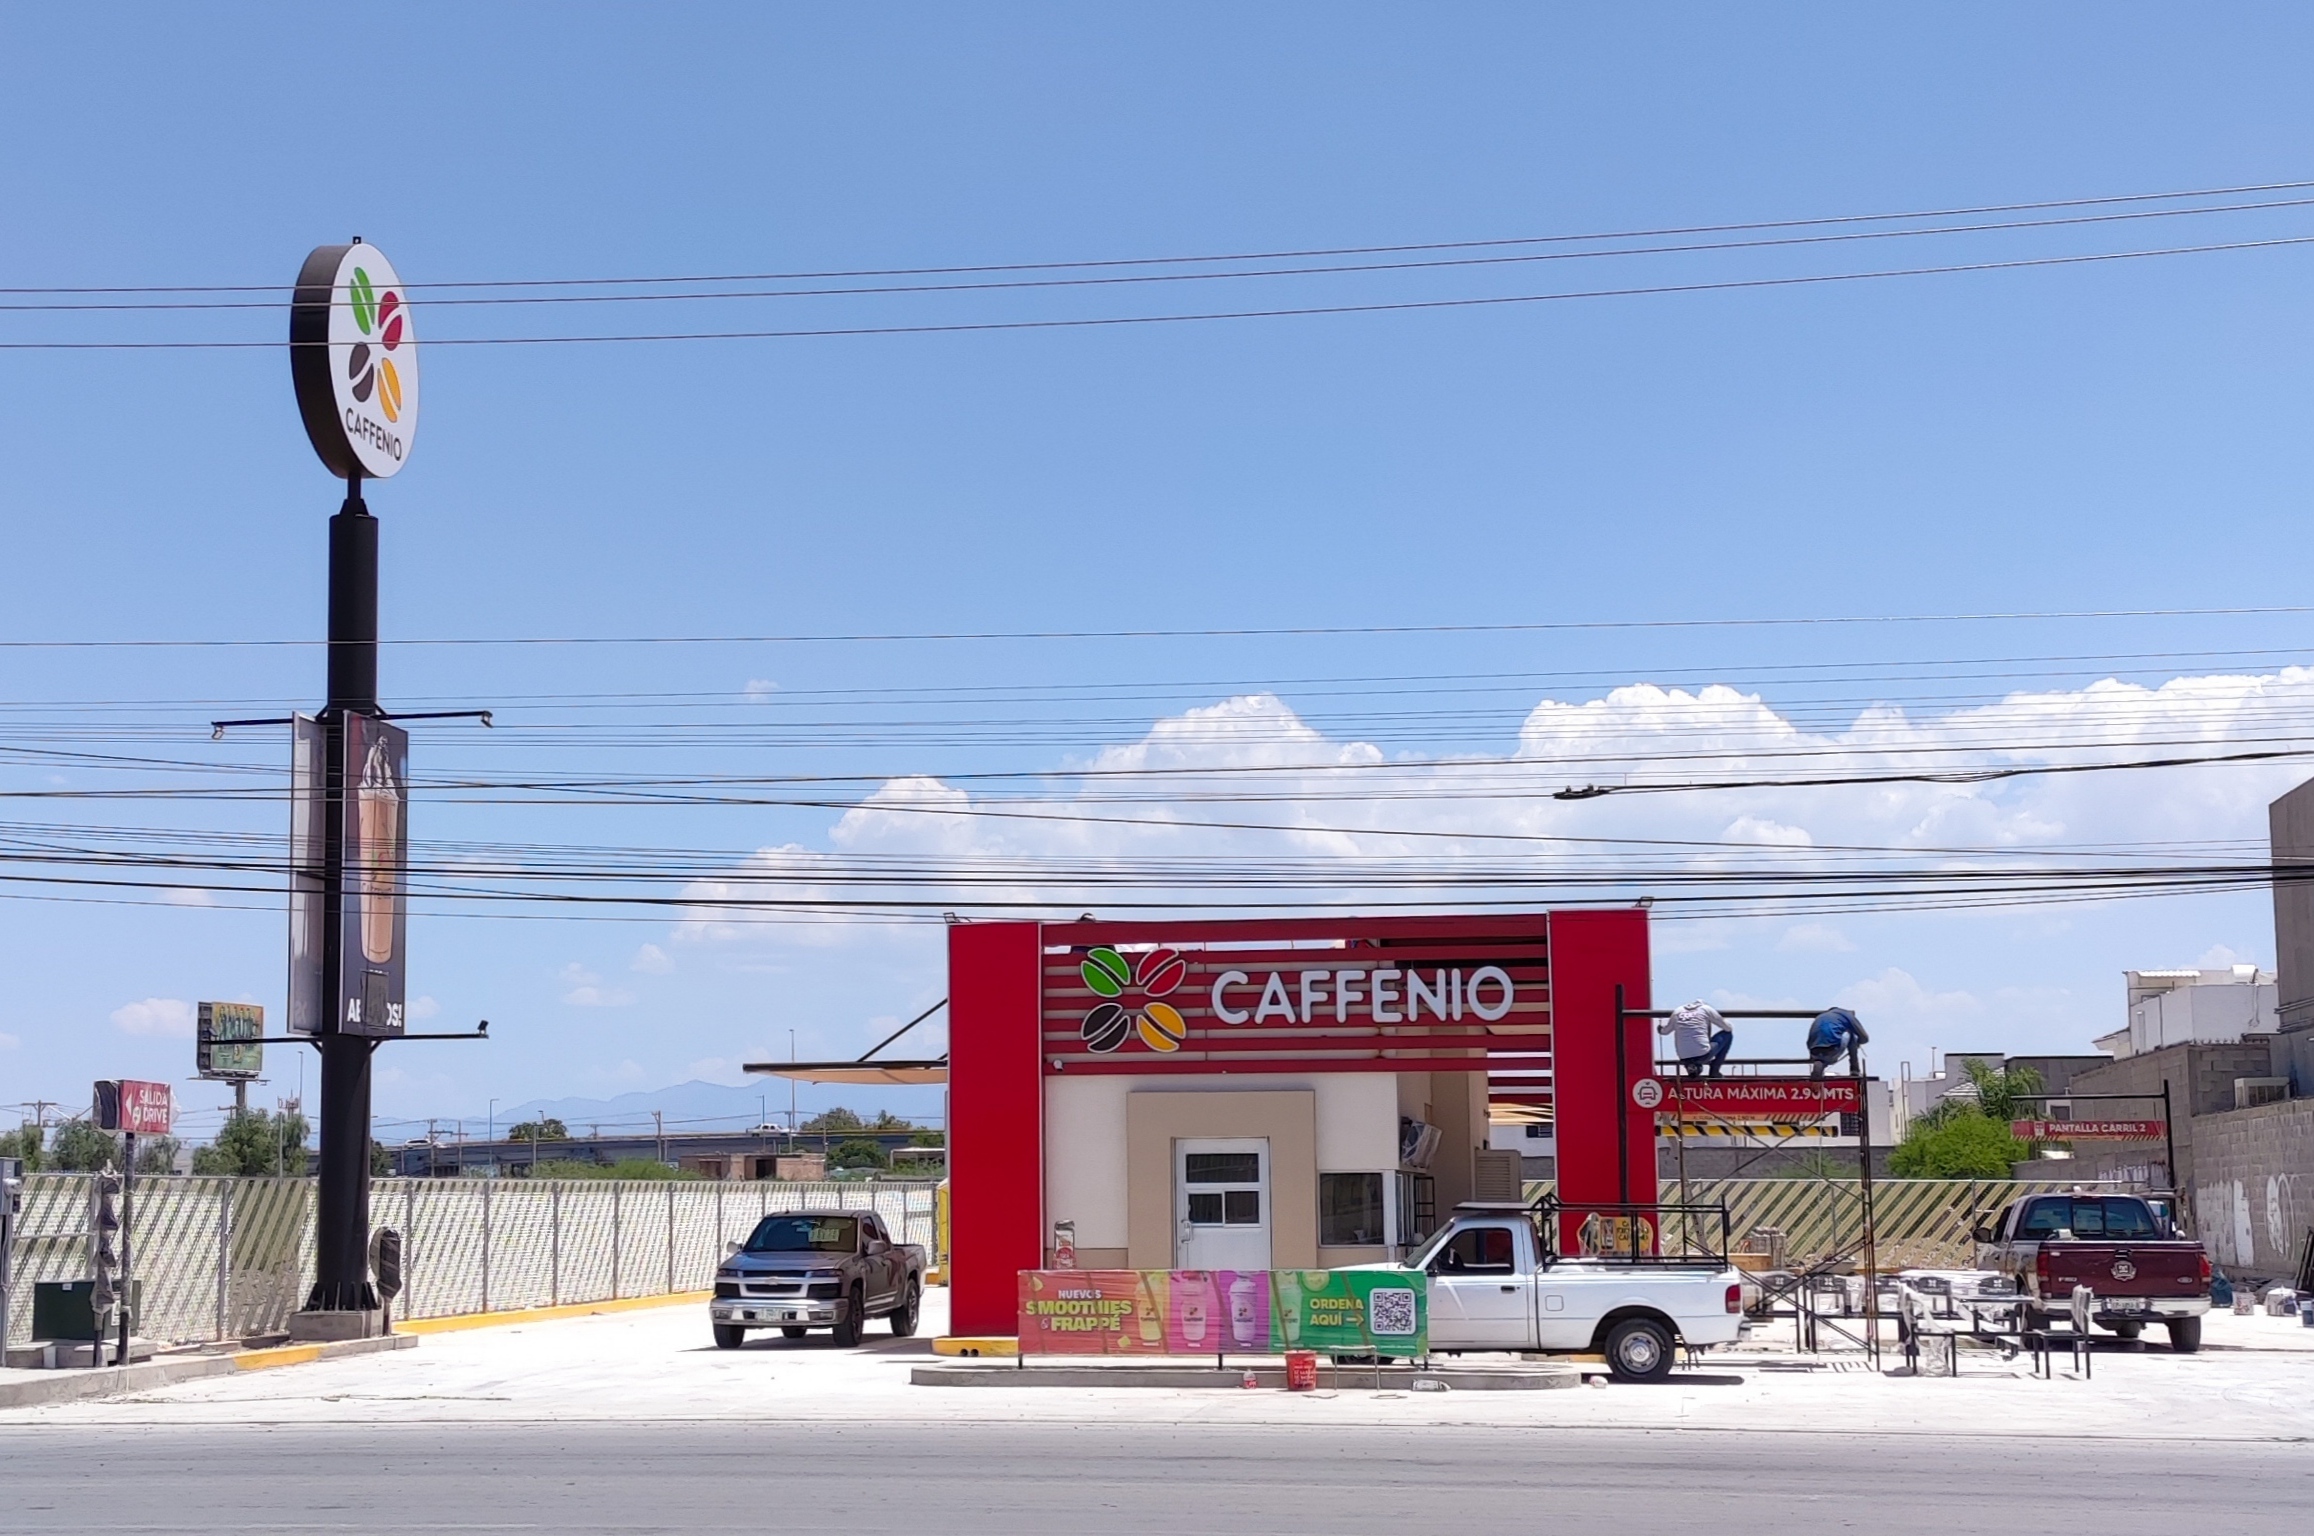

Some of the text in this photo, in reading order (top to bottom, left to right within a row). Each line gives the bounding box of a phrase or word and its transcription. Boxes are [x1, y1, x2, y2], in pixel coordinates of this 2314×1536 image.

[346, 407, 402, 462] CAFFENIO
[1211, 965, 1514, 1025] CAFFENIO
[140, 1088, 168, 1107] SALIDA
[1667, 1086, 1723, 1100] ATURA
[1727, 1084, 1787, 1100] MÁXIMA
[1823, 1087, 1854, 1100] MTS
[143, 1106, 168, 1124] DRIVE
[2049, 1123, 2147, 1133] PANTALLA CARRIL 2
[1058, 1289, 1102, 1299] NUEVOS
[1310, 1298, 1364, 1311] ORDENA
[1051, 1314, 1121, 1331] FRAPPÉ
[1310, 1311, 1343, 1326] AQUÍ
